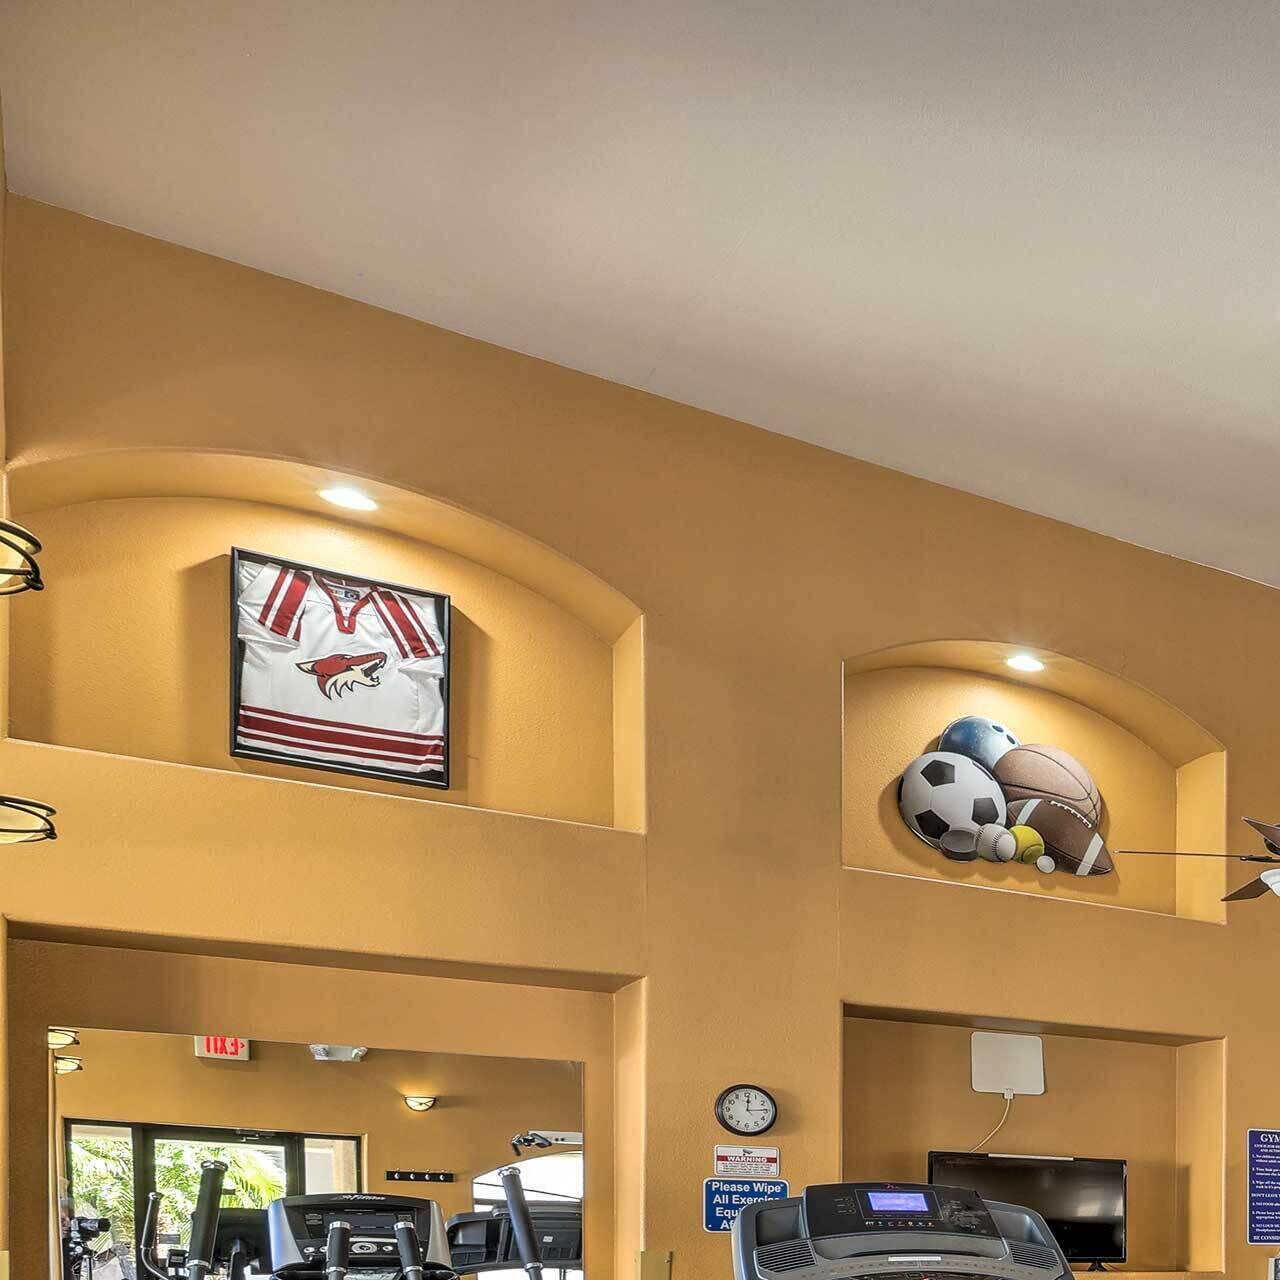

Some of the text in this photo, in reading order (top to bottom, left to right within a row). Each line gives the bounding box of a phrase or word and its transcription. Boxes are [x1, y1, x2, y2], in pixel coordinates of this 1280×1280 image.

[712, 1182, 782, 1194] Please Wipe
[712, 1194, 780, 1204] All Exerci
